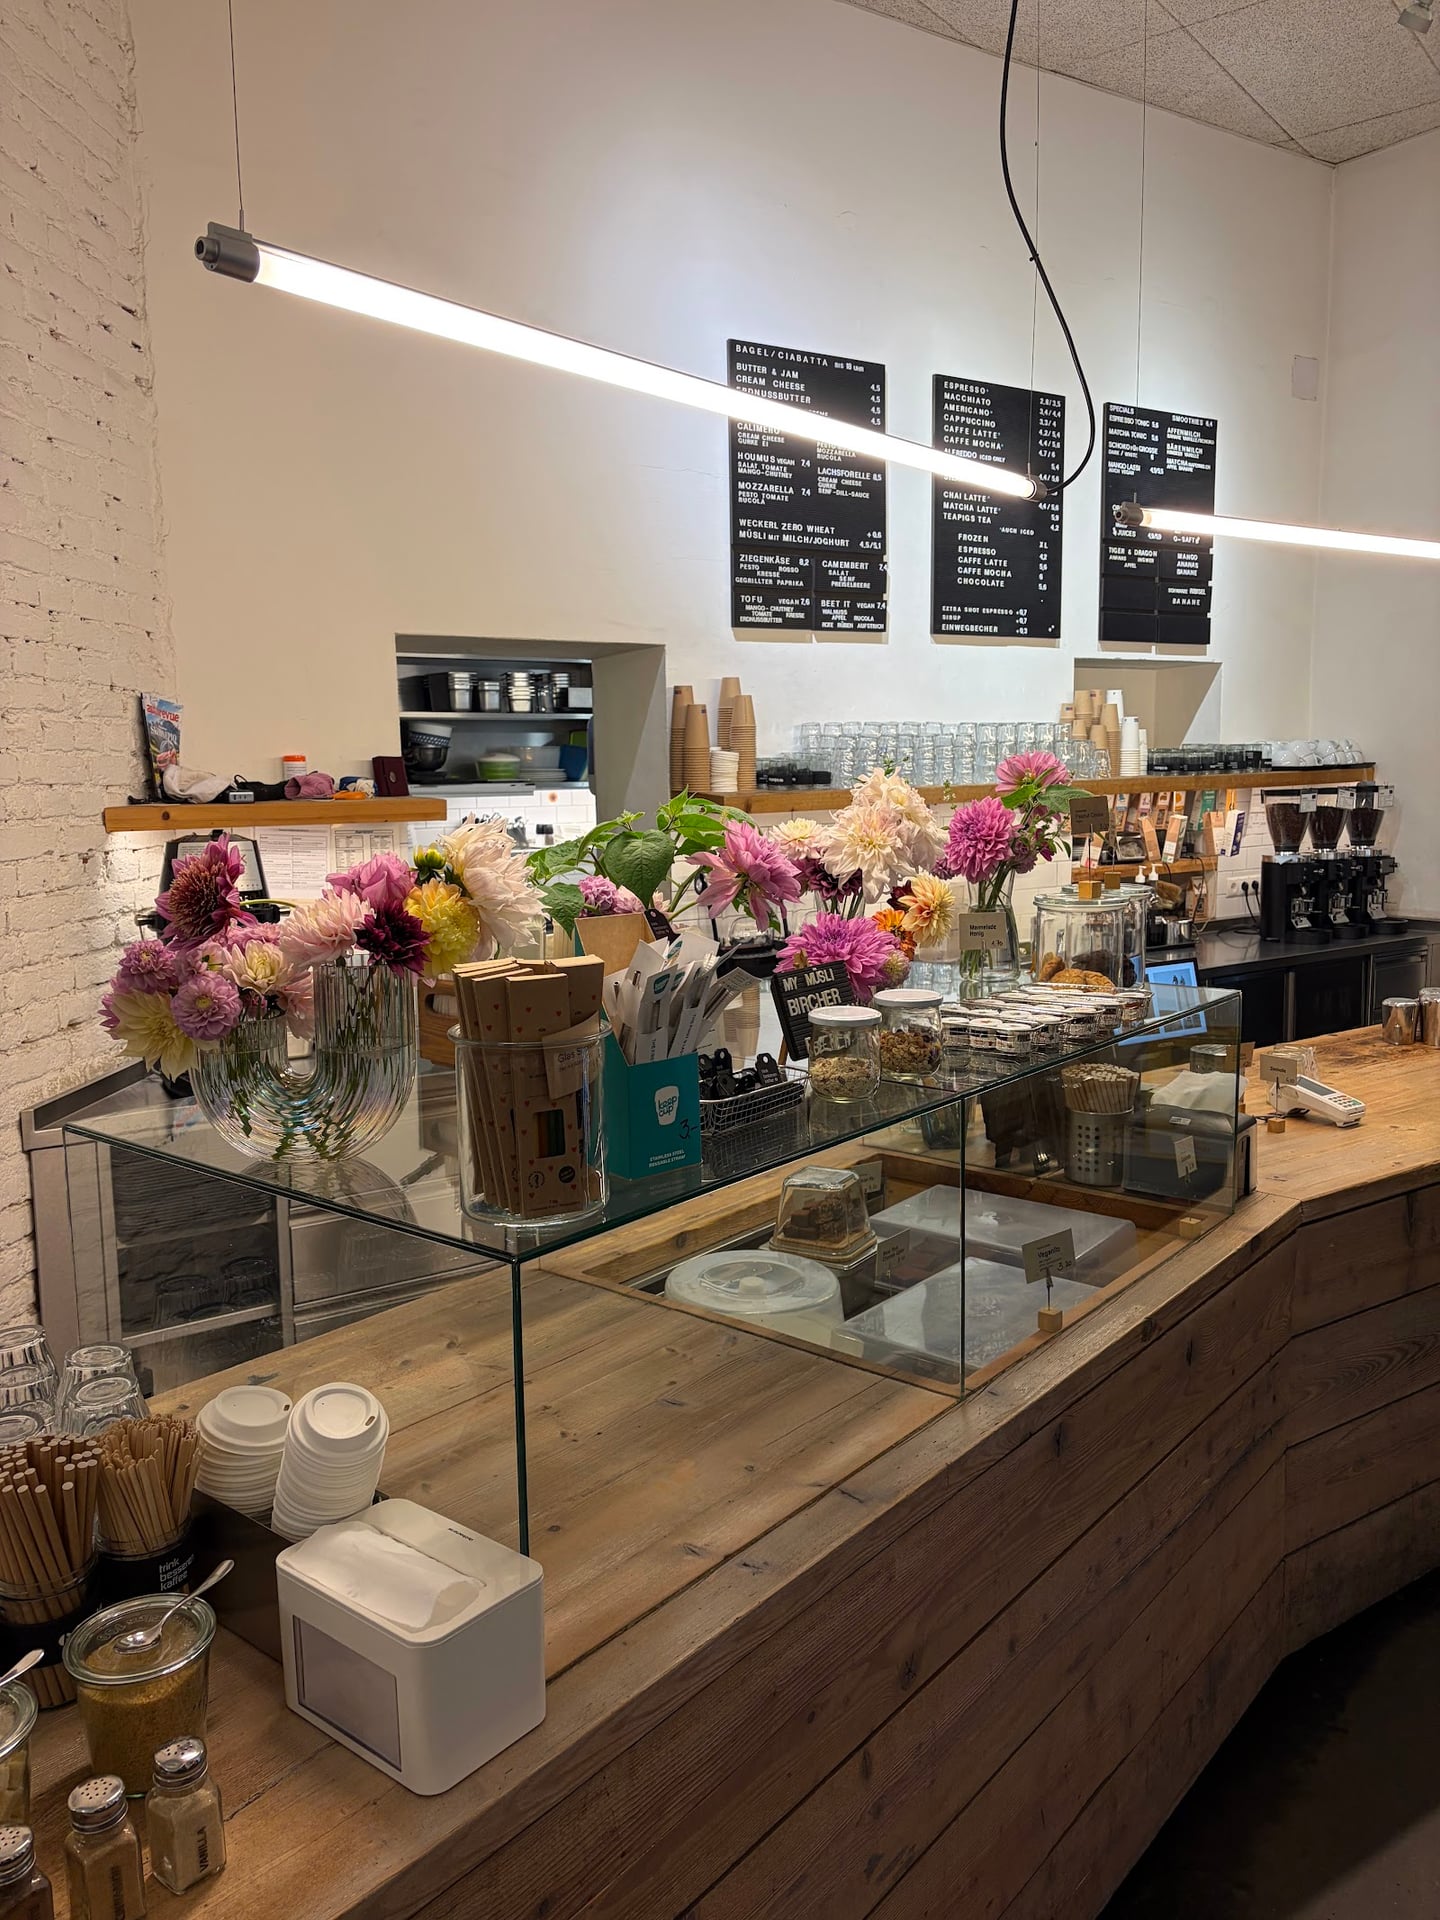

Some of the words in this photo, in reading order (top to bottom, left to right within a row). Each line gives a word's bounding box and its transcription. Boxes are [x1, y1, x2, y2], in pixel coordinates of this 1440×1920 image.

[736, 345, 828, 366] BAGEL/CIABATTA
[736, 363, 767, 374] BUTTER
[781, 370, 799, 378] JAM
[736, 375, 766, 385] CREAM
[773, 380, 805, 391] CHEESE
[944, 392, 991, 406] MACCHIATO
[1109, 405, 1134, 414] SPECIALS
[944, 414, 996, 428] CAPPUCCINO
[944, 425, 969, 435] CAFFE
[738, 432, 760, 440] CREAM
[762, 435, 784, 443] CHEESE
[944, 436, 969, 446] CAFFE
[817, 448, 856, 457] MOZZARELLA
[738, 452, 775, 463] HOUMUS
[777, 458, 795, 466] VEGAN
[738, 461, 759, 470] SALAT
[762, 464, 787, 472] TOMATE
[738, 468, 793, 479] MANGO-CHUTNEY
[818, 467, 870, 480] LACHSFORELLE
[738, 482, 794, 494] MOZZARELLA
[738, 491, 758, 499] PESTO
[762, 493, 789, 502] TOMATE
[738, 497, 765, 505] RUCOLA
[943, 491, 961, 500] CHAI
[943, 502, 974, 512] MATCHA
[943, 513, 975, 522] TEAPIGS
[978, 516, 992, 524] TEA
[739, 519, 778, 530] WECKERL
[782, 523, 802, 532] ZERO
[807, 525, 835, 534] WHEAT
[739, 530, 767, 540] MÜSLI
[783, 535, 850, 547] MILCH/JOGHURT
[958, 533, 989, 543] FROZEN
[958, 546, 996, 555] ESPRESSO
[1109, 547, 1125, 555] TIGER
[1134, 549, 1158, 557] DRAGON
[740, 554, 790, 565] ZIEGENKÄSE
[958, 556, 982, 565] CAFFE
[984, 559, 1008, 567] LATTE
[1177, 553, 1198, 561] MANGO
[822, 560, 869, 570] CAMEMBERT
[1177, 561, 1199, 569] ANANAS
[958, 567, 982, 575] CAFFE
[984, 569, 1012, 578] MOCHA
[957, 577, 1005, 588] CHOCOLATE
[740, 595, 763, 603] TOFU
[1172, 598, 1200, 606] BANANE
[942, 623, 998, 632] EINWEGBECHER
[782, 977, 798, 992] MY
[804, 968, 834, 987] MÜSLI
[787, 988, 842, 1017] BIRCHER
[658, 1096, 677, 1109] keep
[659, 1106, 674, 1117] cup
[159, 1558, 179, 1573] trink
[161, 1570, 188, 1591] kaffee
[196, 1826, 209, 1873] VANILLA
